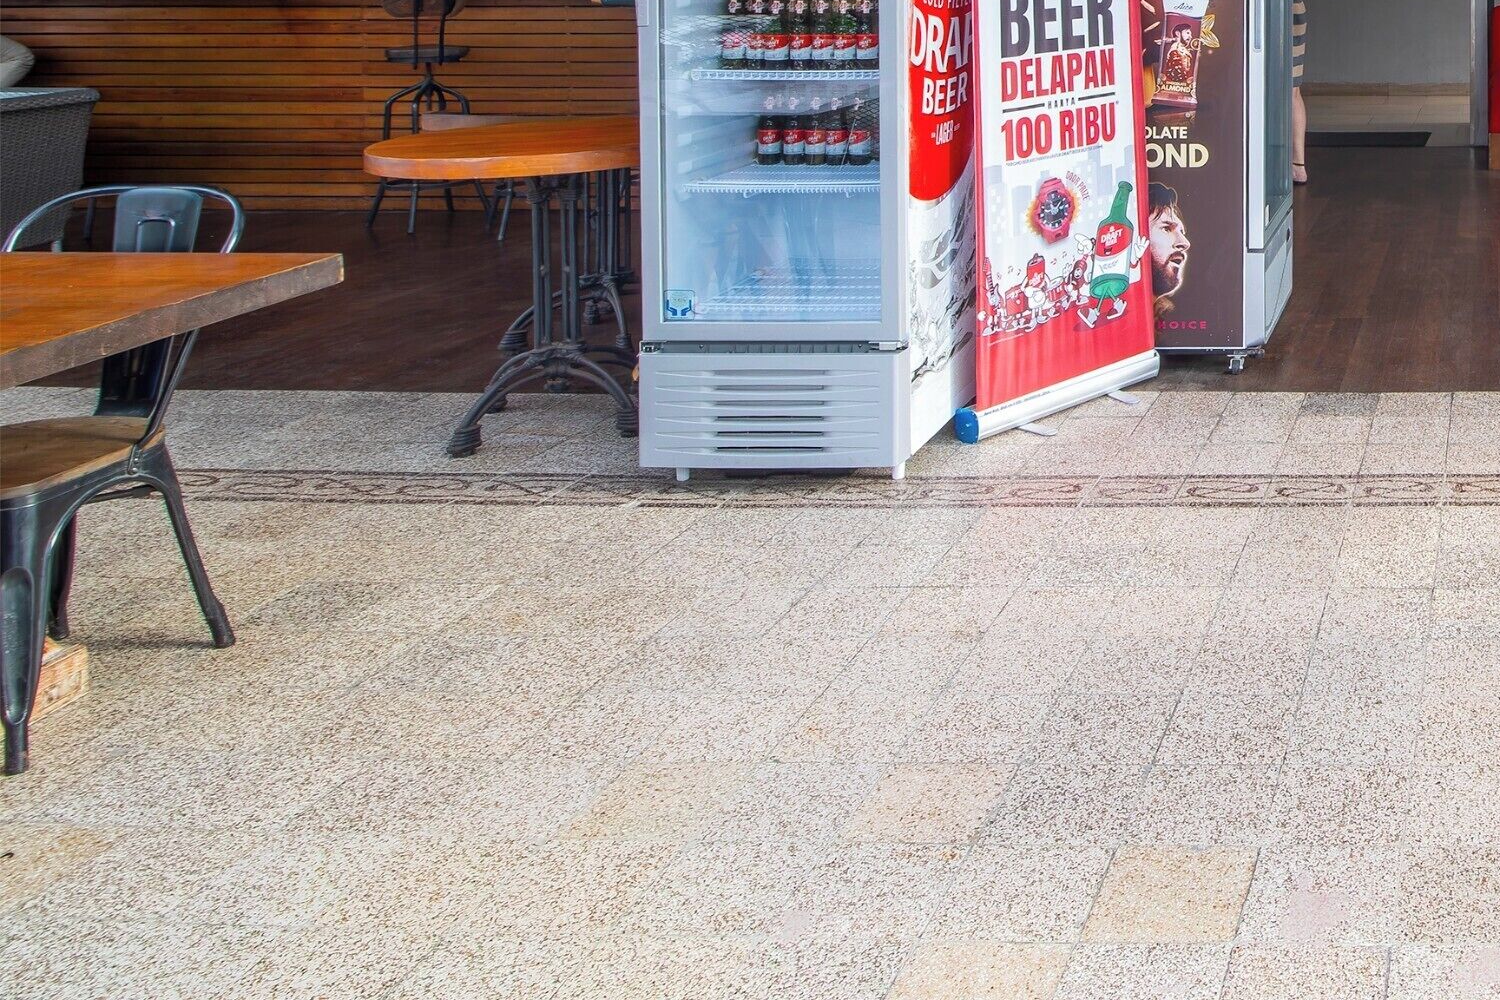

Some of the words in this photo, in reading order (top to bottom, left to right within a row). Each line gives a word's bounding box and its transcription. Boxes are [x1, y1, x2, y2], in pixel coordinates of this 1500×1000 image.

[1174, 2, 1193, 11] Aice
[1001, 47, 1116, 103] DELAPAN
[921, 71, 968, 116] BEER
[1161, 85, 1191, 93] ALMOND
[1047, 96, 1076, 110] HANYA
[935, 119, 954, 146] LAGER
[1001, 112, 1051, 162] 100
[1100, 228, 1124, 244] DRAFT
